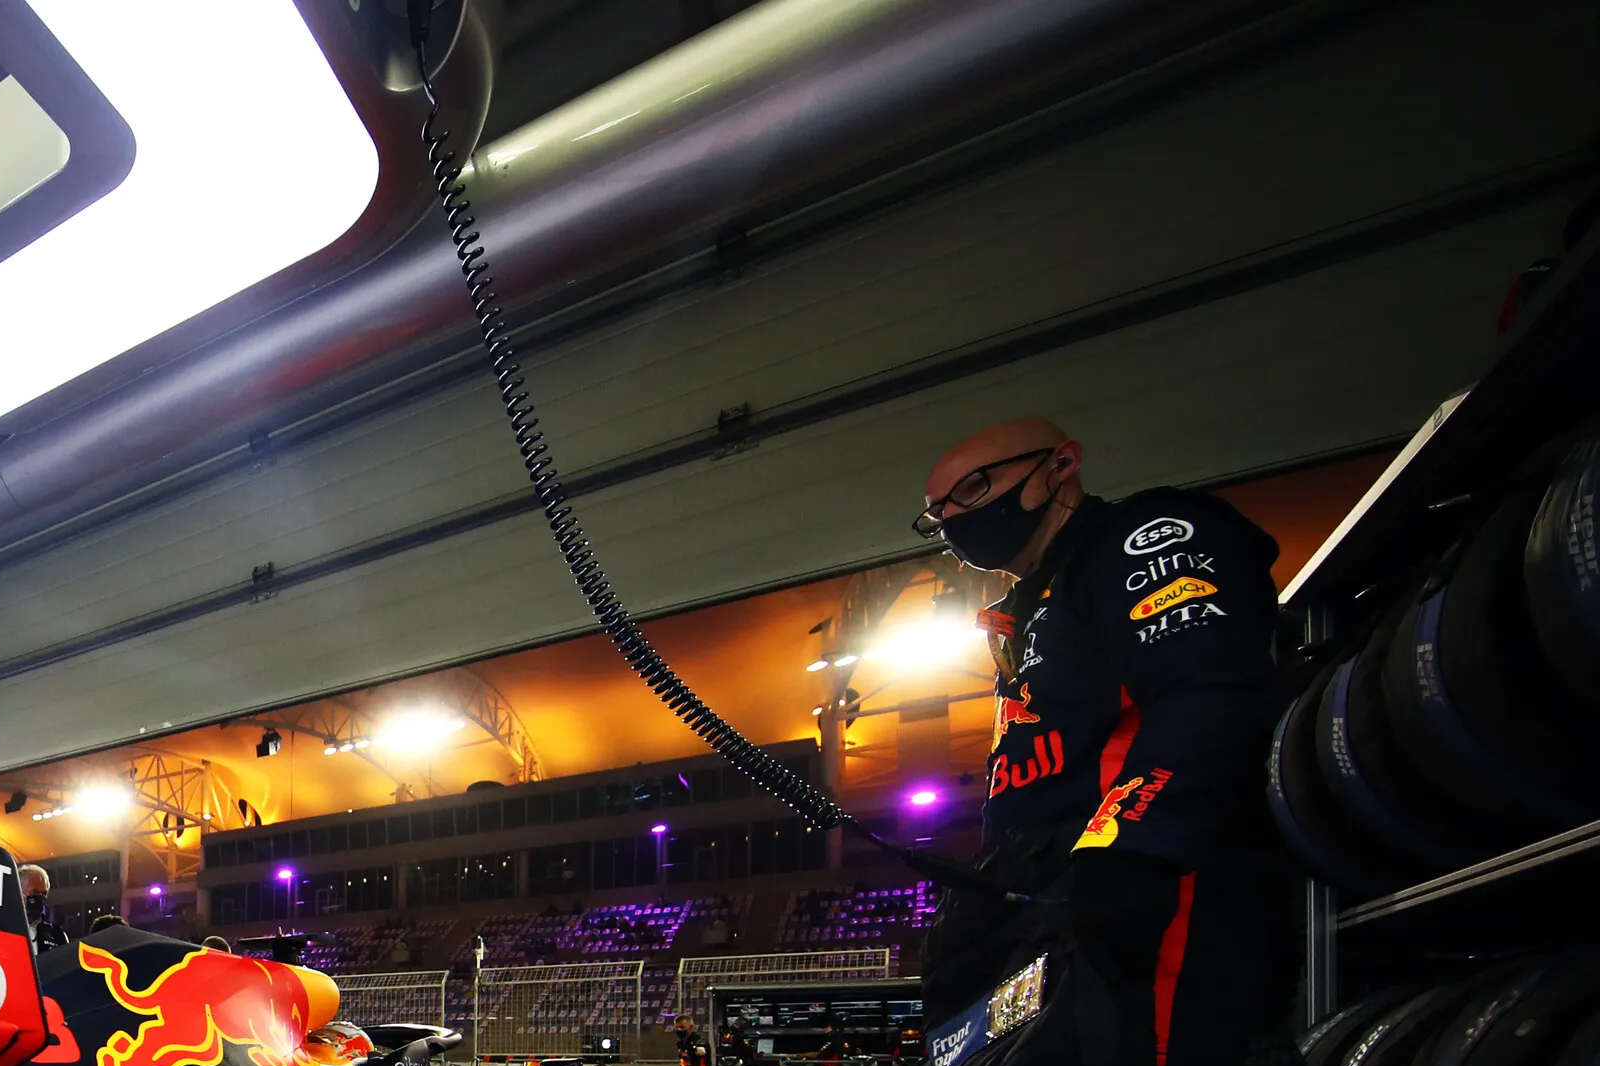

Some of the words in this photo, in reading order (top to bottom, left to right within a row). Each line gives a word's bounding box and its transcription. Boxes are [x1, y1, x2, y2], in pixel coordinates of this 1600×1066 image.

[1126, 552, 1216, 591] citrix
[1154, 582, 1207, 609] RAUCH
[1135, 603, 1228, 643] DITA
[990, 729, 1065, 800] Bull
[932, 1020, 972, 1057] Front
